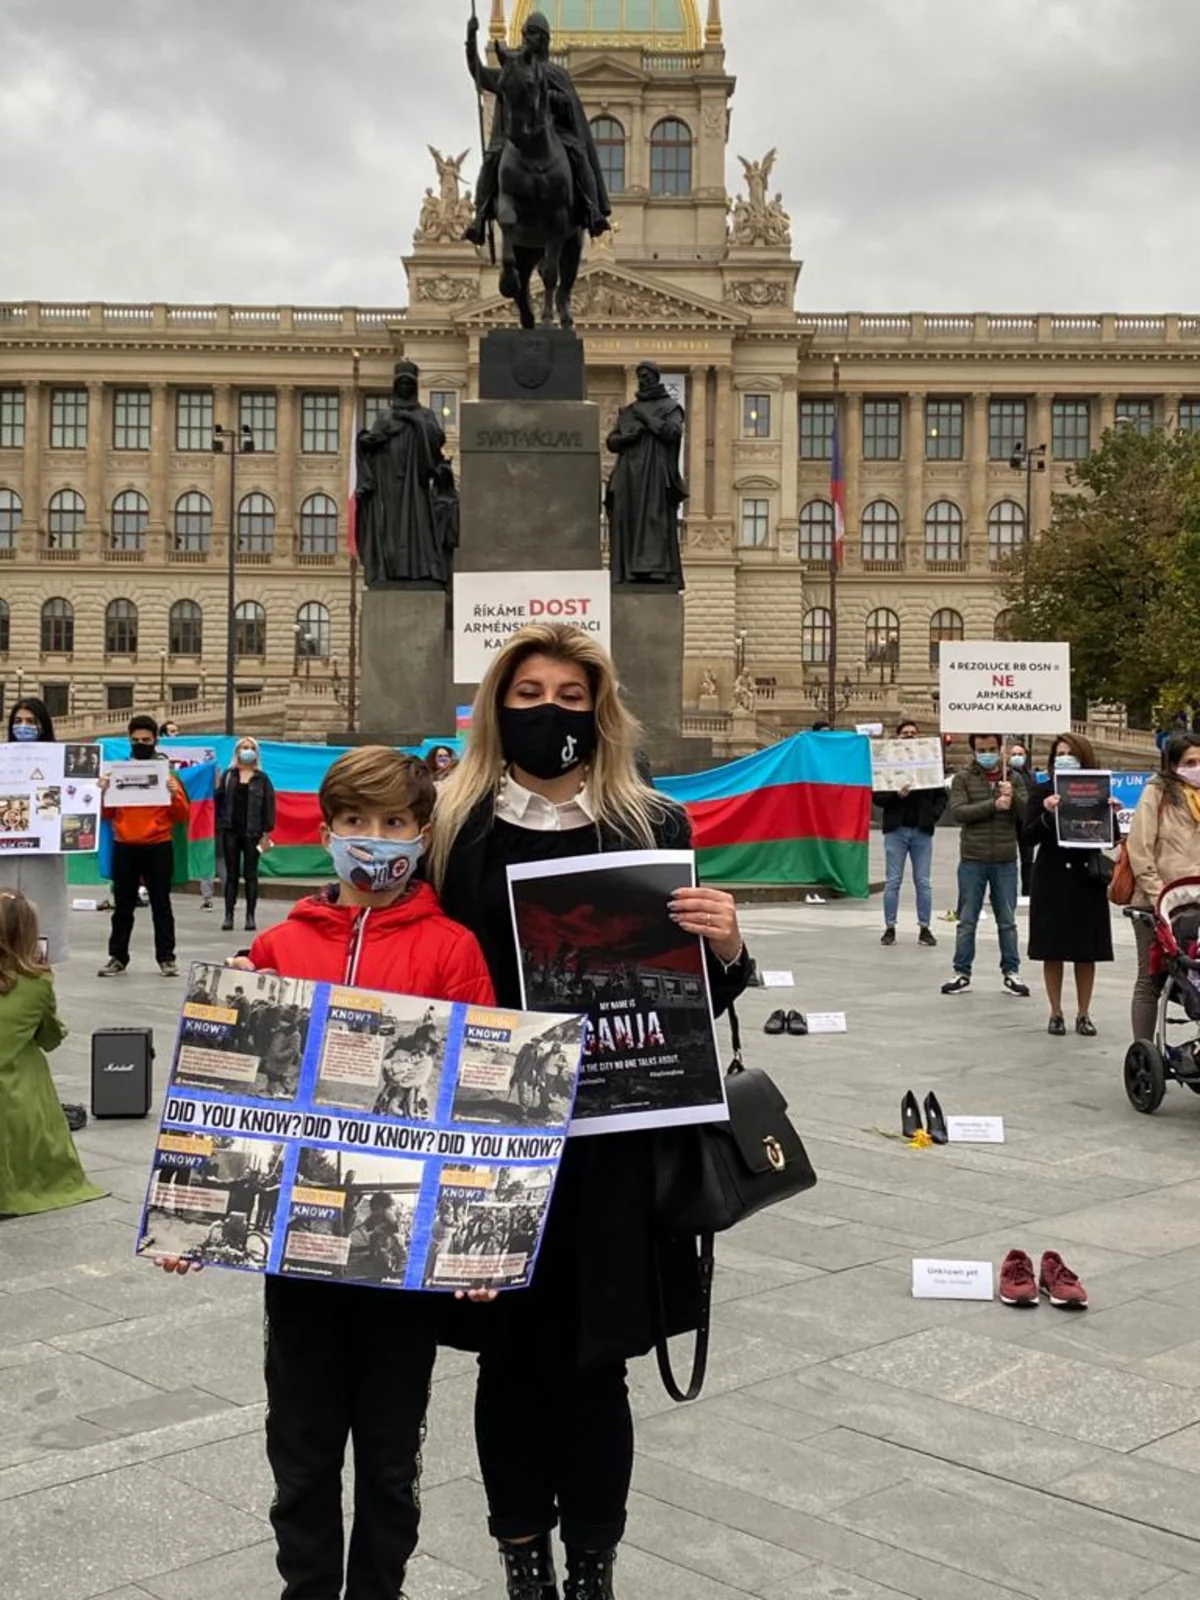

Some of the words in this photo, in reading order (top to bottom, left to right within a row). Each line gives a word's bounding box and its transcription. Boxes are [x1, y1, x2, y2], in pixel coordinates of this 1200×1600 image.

[474, 603, 525, 617] ŘÍKÁME
[529, 598, 591, 616] DOST
[949, 661, 956, 671] 4
[957, 662, 1011, 671] REZOLUCE
[1013, 662, 1027, 671] RB
[1029, 662, 1051, 671] OSN
[992, 675, 1015, 687] NE
[976, 689, 1032, 699] ARMÉNSKÉ
[948, 702, 994, 712] OKUPACI
[997, 703, 1062, 712] KARABACHU
[1126, 776, 1142, 785] UN
[331, 1009, 371, 1023] KNOW?
[186, 1020, 228, 1034] KNOW?
[467, 1027, 508, 1041] KNOW?
[166, 1099, 196, 1122] DID
[202, 1103, 235, 1128] YOU
[239, 1110, 302, 1136] KNOW?
[303, 1116, 331, 1139] DID
[338, 1120, 370, 1146] YOU
[374, 1126, 435, 1152] KNOW?
[438, 1132, 465, 1154] DID
[471, 1135, 500, 1157] YOU
[506, 1137, 562, 1158] KNOW?
[160, 1152, 203, 1167] KNOW?
[442, 1187, 482, 1199] KNOW?
[293, 1206, 336, 1220] KNOW?
